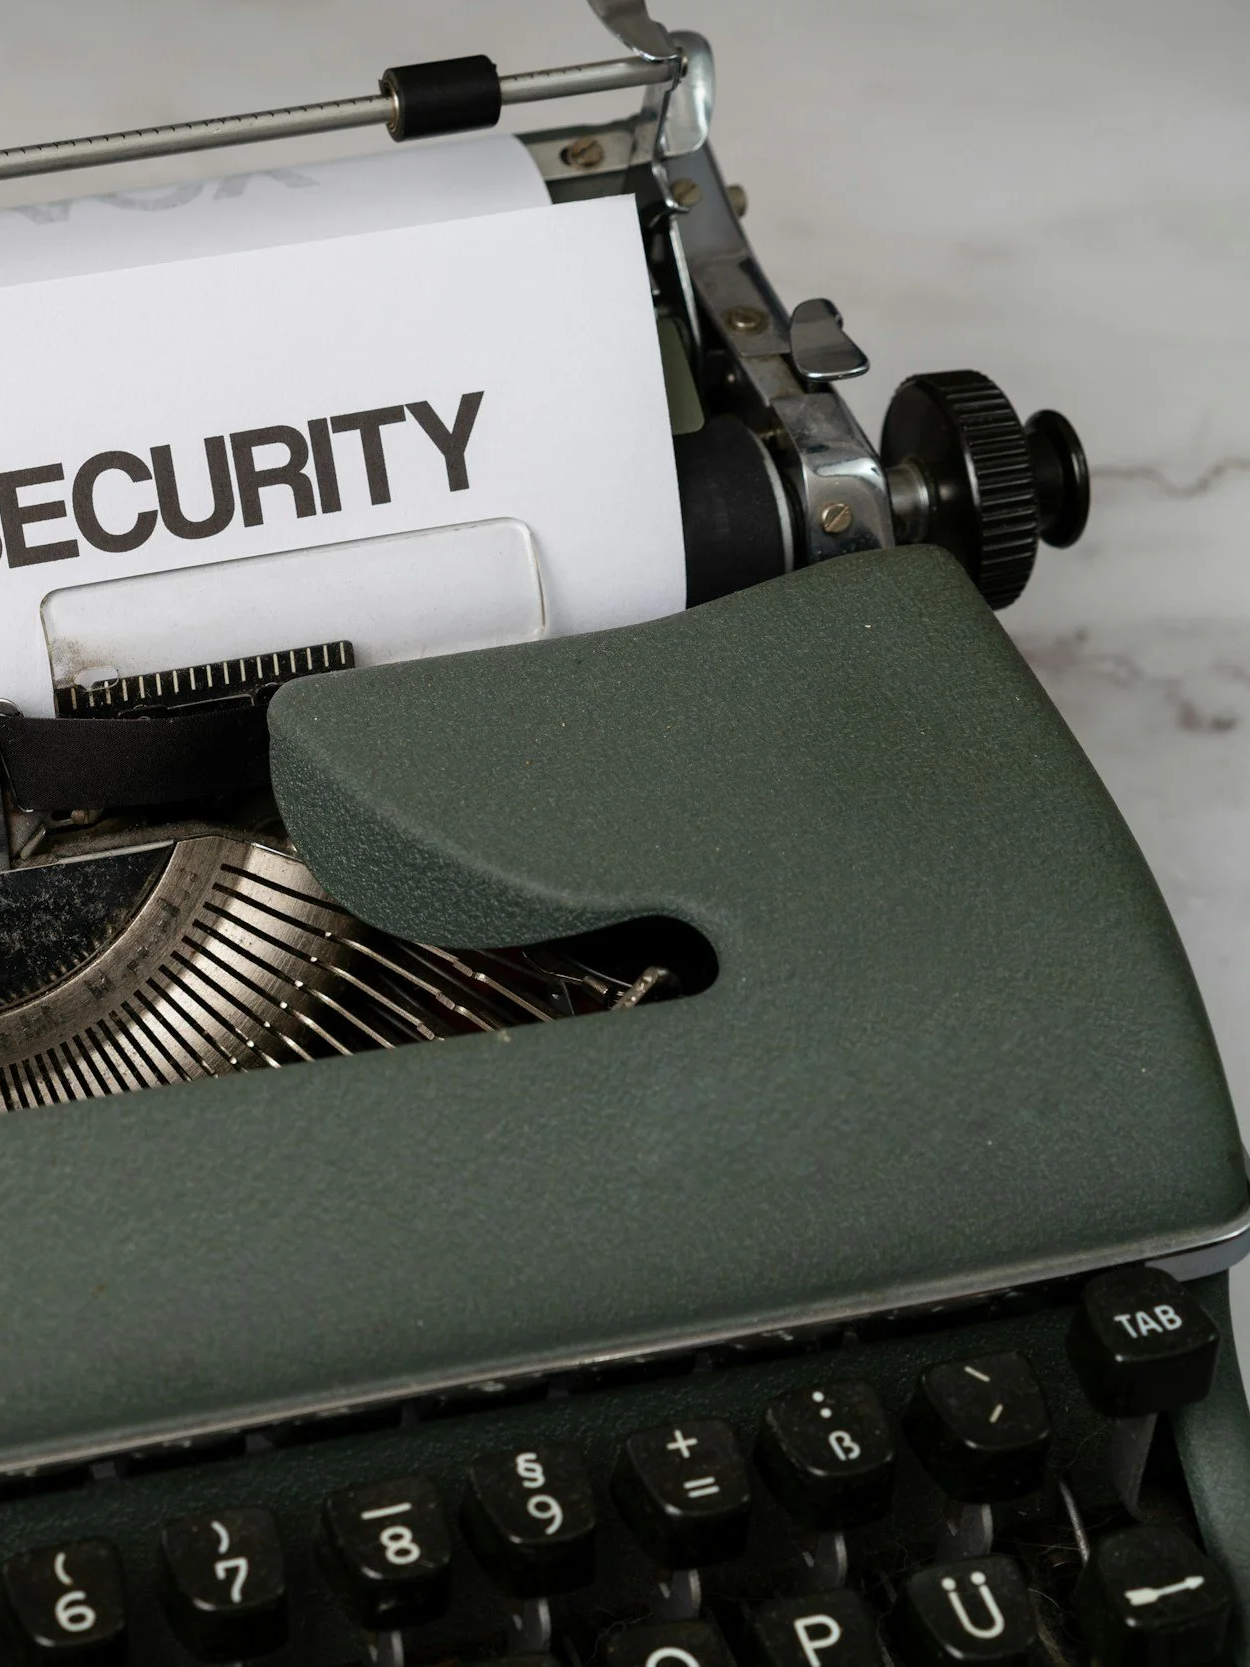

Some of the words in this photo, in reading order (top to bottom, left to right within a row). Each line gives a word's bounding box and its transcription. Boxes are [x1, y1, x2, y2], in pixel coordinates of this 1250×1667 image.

[1113, 1304, 1183, 1339] TAB
[667, 1429, 698, 1458] +
[683, 1476, 720, 1498] =
[527, 1494, 563, 1535] 9
[379, 1525, 421, 1565] 8
[214, 1557, 248, 1603] 7
[54, 1590, 96, 1632] 6
[941, 1571, 1005, 1639] Ü
[793, 1614, 841, 1667] P
